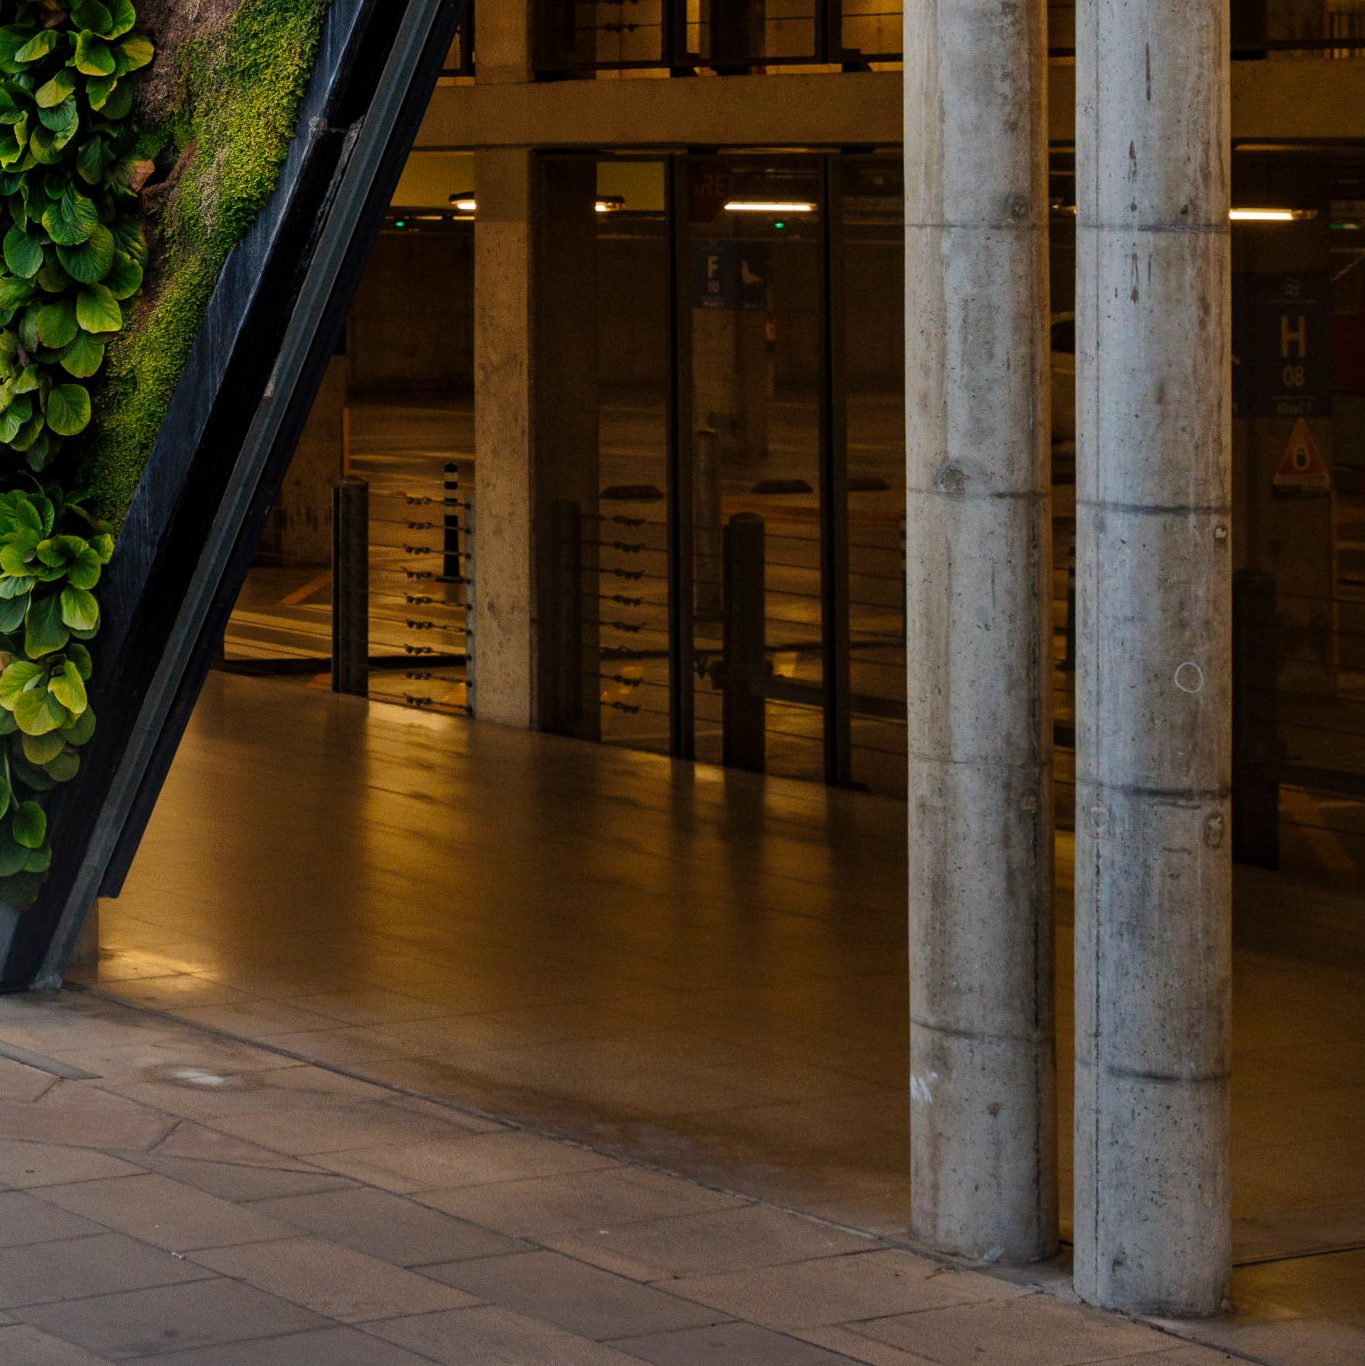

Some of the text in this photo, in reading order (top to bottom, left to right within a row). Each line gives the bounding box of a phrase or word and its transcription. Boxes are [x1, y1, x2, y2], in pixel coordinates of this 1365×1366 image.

[707, 255, 719, 278] F
[1280, 315, 1306, 358] H
[1282, 365, 1306, 388] 08
